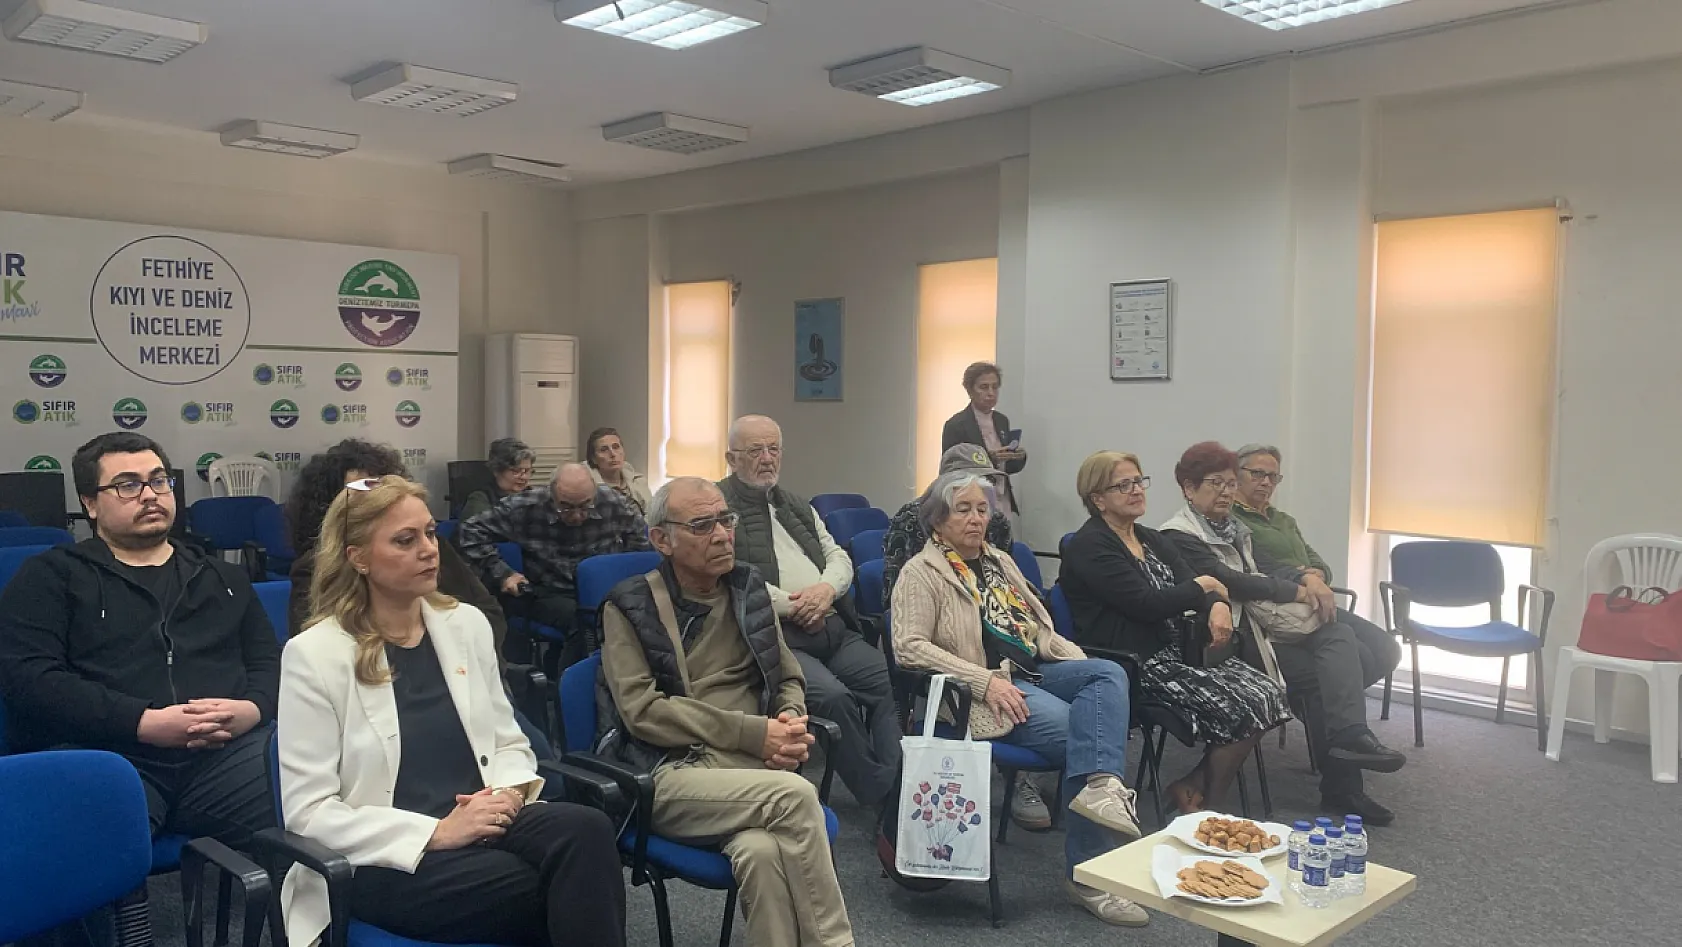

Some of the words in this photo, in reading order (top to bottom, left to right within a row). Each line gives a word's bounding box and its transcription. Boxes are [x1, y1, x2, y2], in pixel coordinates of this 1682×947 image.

[142, 257, 214, 280] FETHİYE
[110, 286, 145, 306] KIYI
[152, 288, 175, 307] VE
[182, 287, 233, 309] DENİZ
[130, 312, 223, 337] İNCELEME
[140, 343, 220, 365] MERKEZİ
[277, 365, 303, 375] SIFIR
[406, 368, 429, 377] SIFIR
[277, 374, 303, 384] ATIK
[406, 377, 429, 386] ATIK
[43, 401, 76, 411] SIFIR
[206, 402, 233, 412] SIFIR
[343, 404, 367, 413] SIFIR
[44, 411, 76, 422] ATIK
[206, 412, 233, 422] ATIK
[343, 413, 367, 422] ATIK
